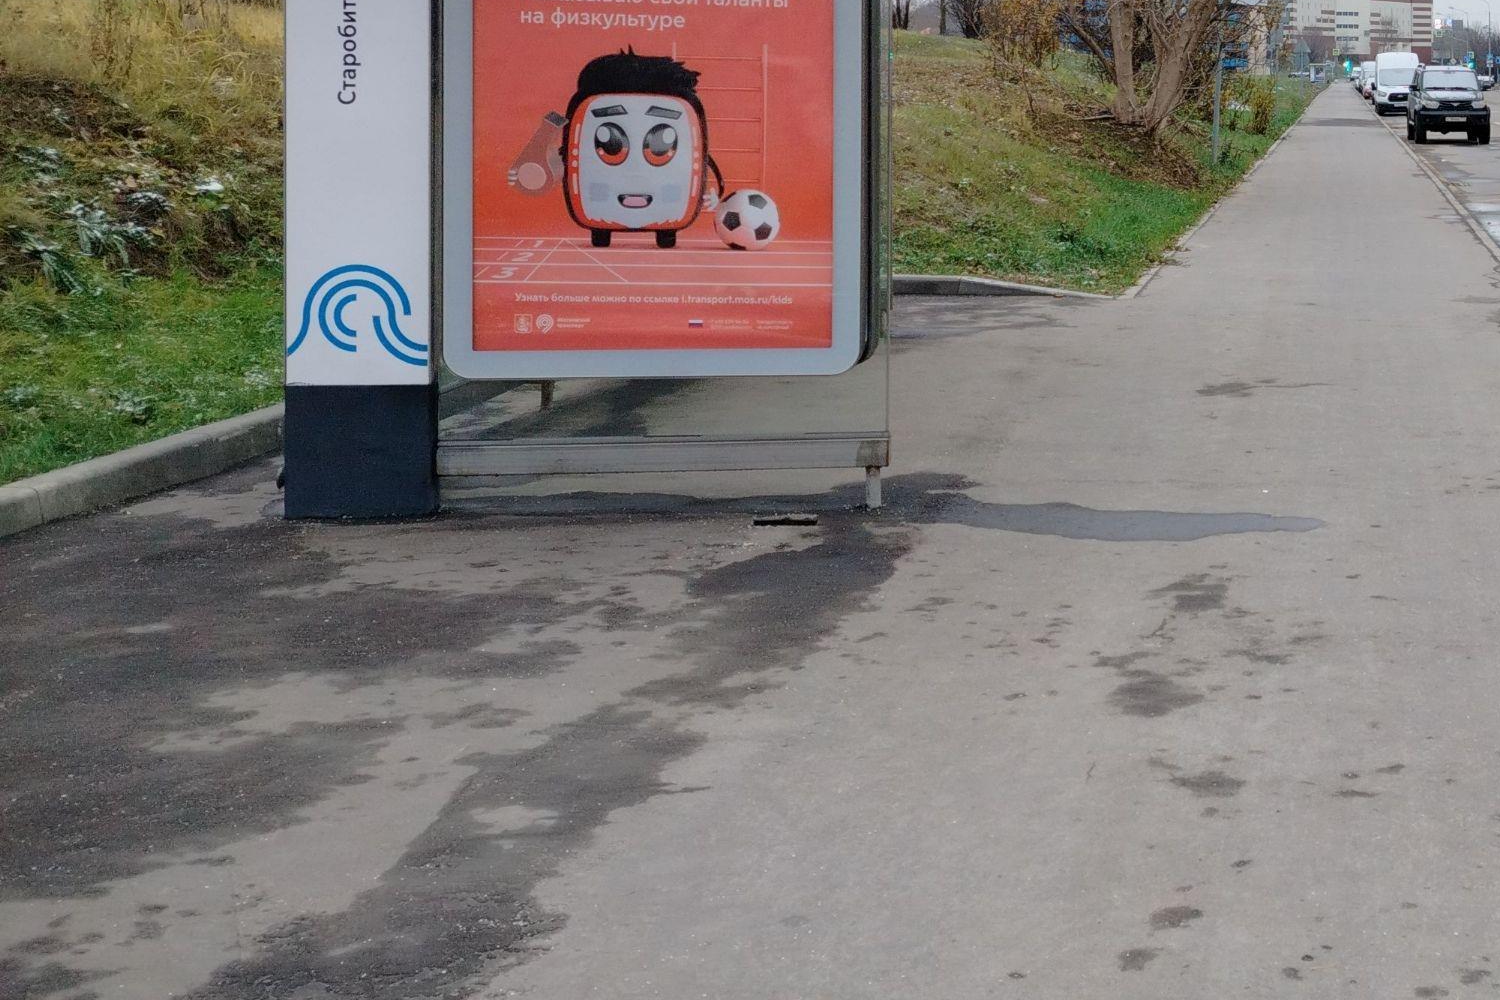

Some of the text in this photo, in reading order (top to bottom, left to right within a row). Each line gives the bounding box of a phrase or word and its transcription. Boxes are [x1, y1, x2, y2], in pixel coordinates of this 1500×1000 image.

[520, 7, 686, 31] на физкультуре
[511, 251, 535, 262] 2
[491, 266, 519, 279] 3
[515, 292, 549, 303] Узнать
[551, 292, 590, 303] больше
[592, 295, 628, 304] можно
[629, 295, 642, 304] по
[644, 295, 679, 304] ссылке
